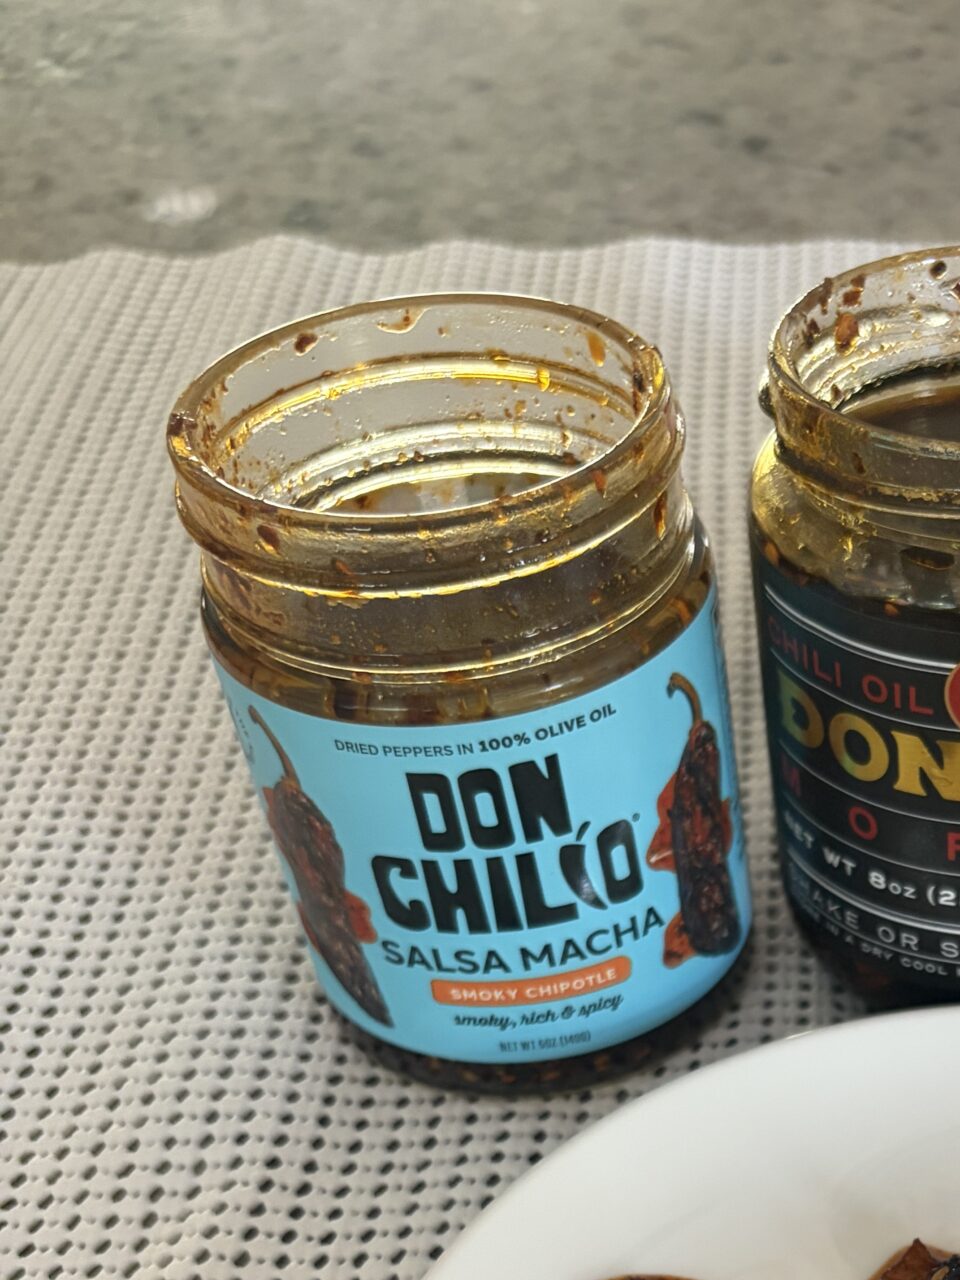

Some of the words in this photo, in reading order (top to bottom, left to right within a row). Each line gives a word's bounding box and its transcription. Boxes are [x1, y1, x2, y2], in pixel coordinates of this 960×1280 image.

[768, 615, 842, 688] CHILI
[861, 674, 934, 716] OIL
[334, 739, 380, 756] DRIED
[383, 744, 454, 757] PEPPERS
[457, 743, 474, 755] IN
[478, 732, 531, 752] 100%
[535, 715, 587, 741] OLIVE
[589, 703, 617, 722] OIL
[405, 753, 573, 853] DON
[822, 847, 857, 876] WT
[381, 940, 512, 975] SALSA
[519, 907, 666, 971] MACHA
[878, 926, 920, 951] OR
[861, 942, 893, 961] DRY
[901, 957, 948, 976] COOL
[450, 987, 518, 1002] SMOKY
[524, 968, 617, 998] CHIPOTLE
[520, 1008, 559, 1025] rich
[561, 1006, 576, 1019] &
[578, 994, 624, 1018] spicy
